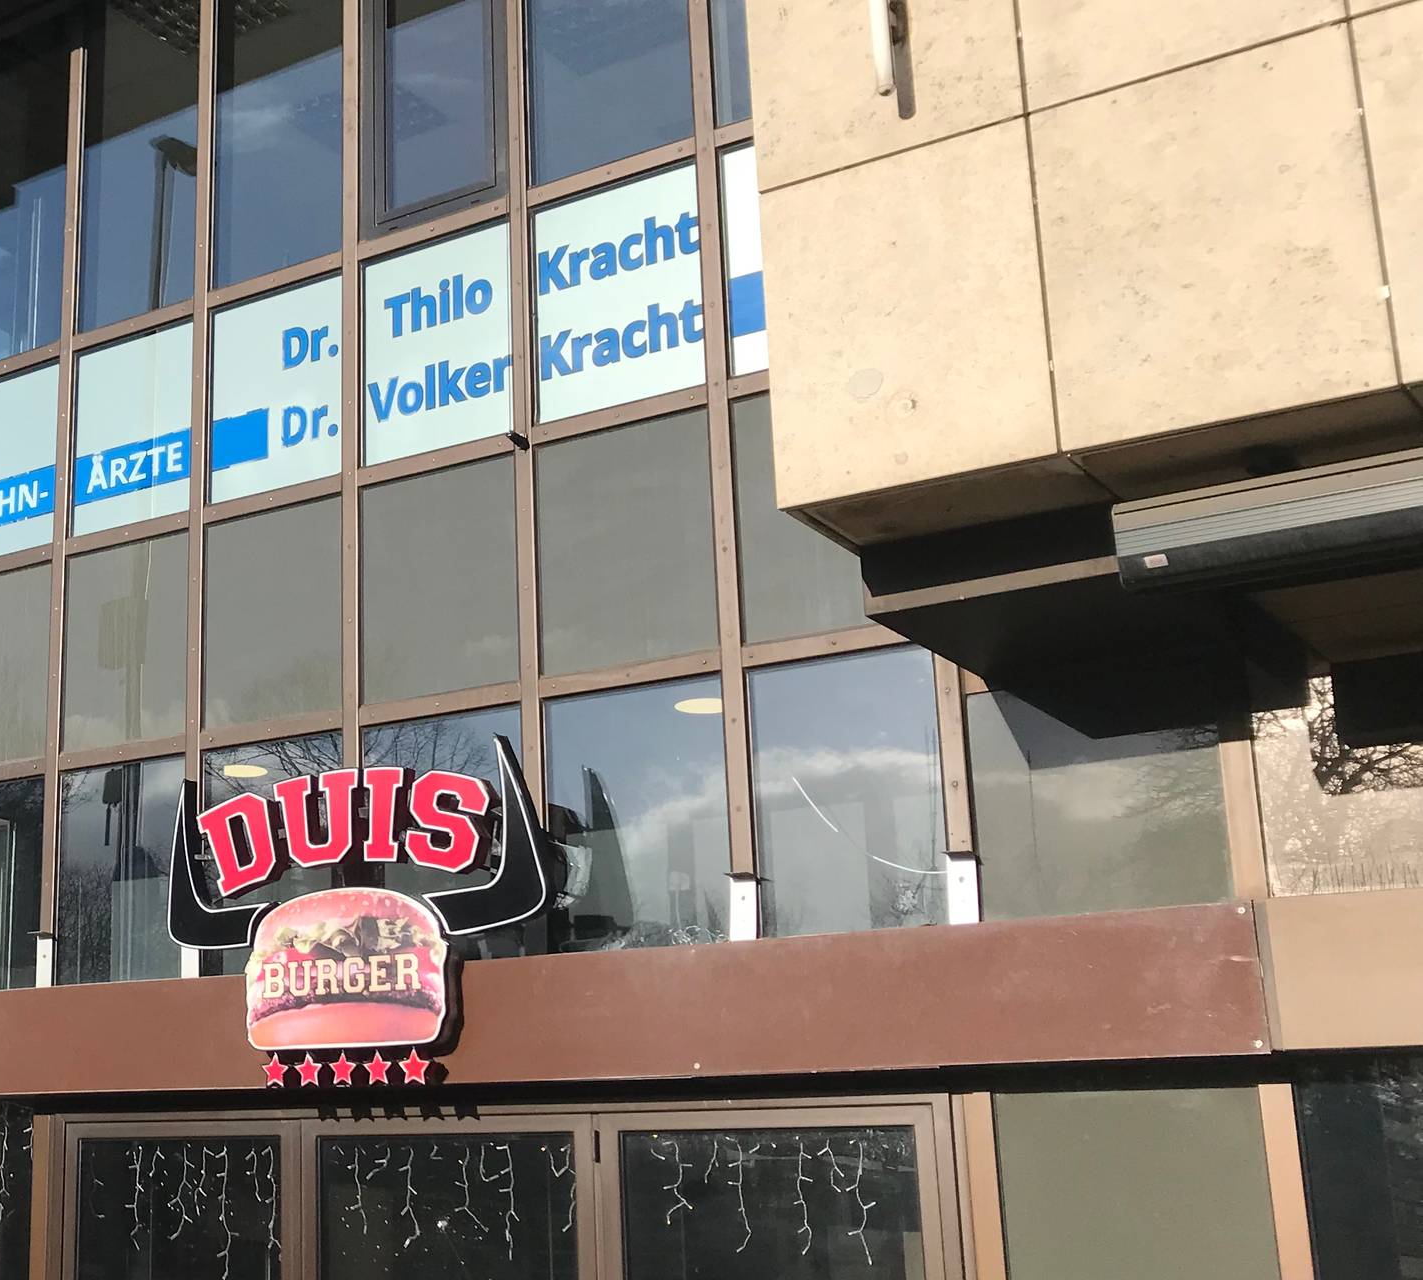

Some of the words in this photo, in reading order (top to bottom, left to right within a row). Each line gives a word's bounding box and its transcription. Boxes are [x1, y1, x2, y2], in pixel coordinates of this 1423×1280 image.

[281, 325, 339, 370] Dr.
[384, 274, 493, 338] Thilo
[538, 211, 700, 296] Kracht
[86, 441, 183, 494] ÄRZTE
[281, 405, 339, 448] Dr.
[368, 354, 513, 423] Volker
[540, 299, 704, 382] Kracht
[196, 767, 490, 897] DUIS
[262, 953, 422, 999] BURGER
